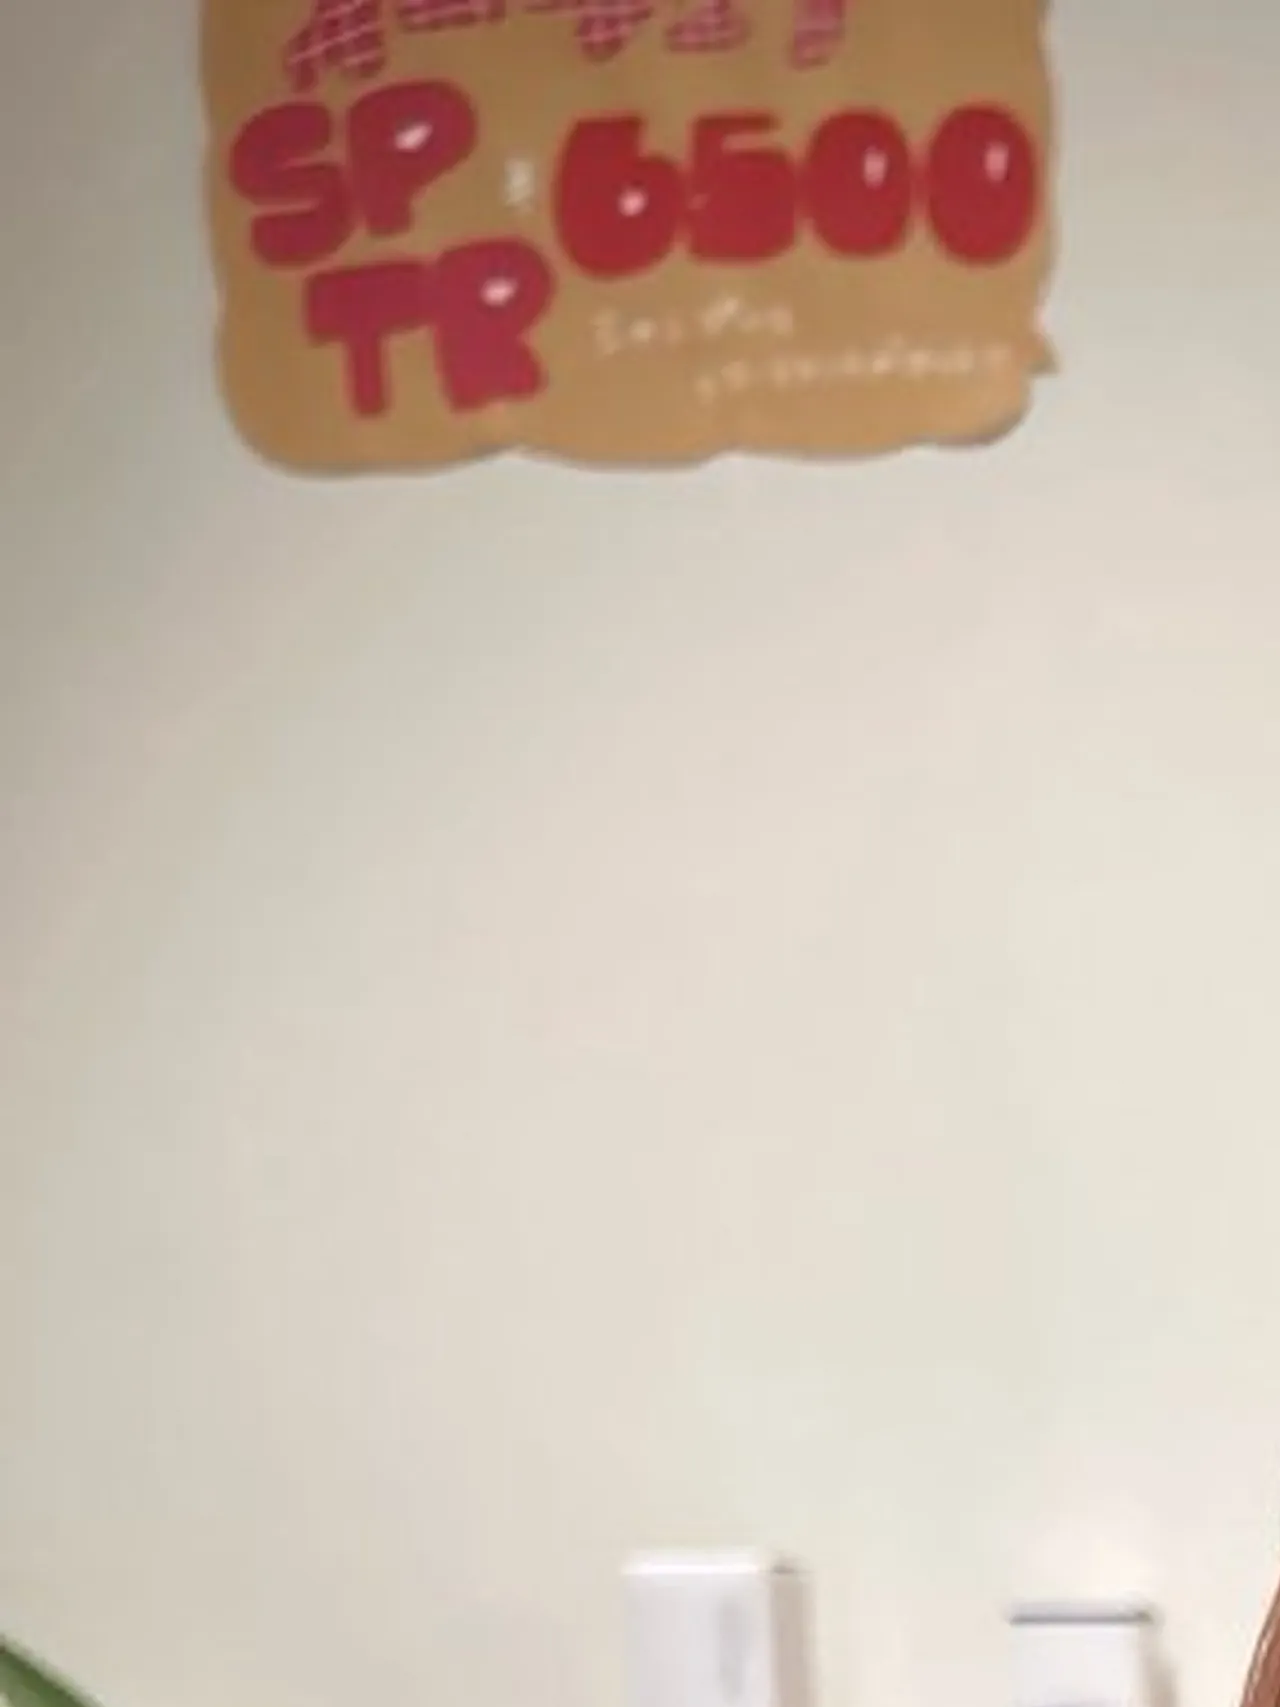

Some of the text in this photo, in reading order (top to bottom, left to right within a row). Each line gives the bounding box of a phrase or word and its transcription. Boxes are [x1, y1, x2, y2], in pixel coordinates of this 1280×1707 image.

[228, 79, 1038, 279] SP 6500
[302, 236, 556, 418] TR
